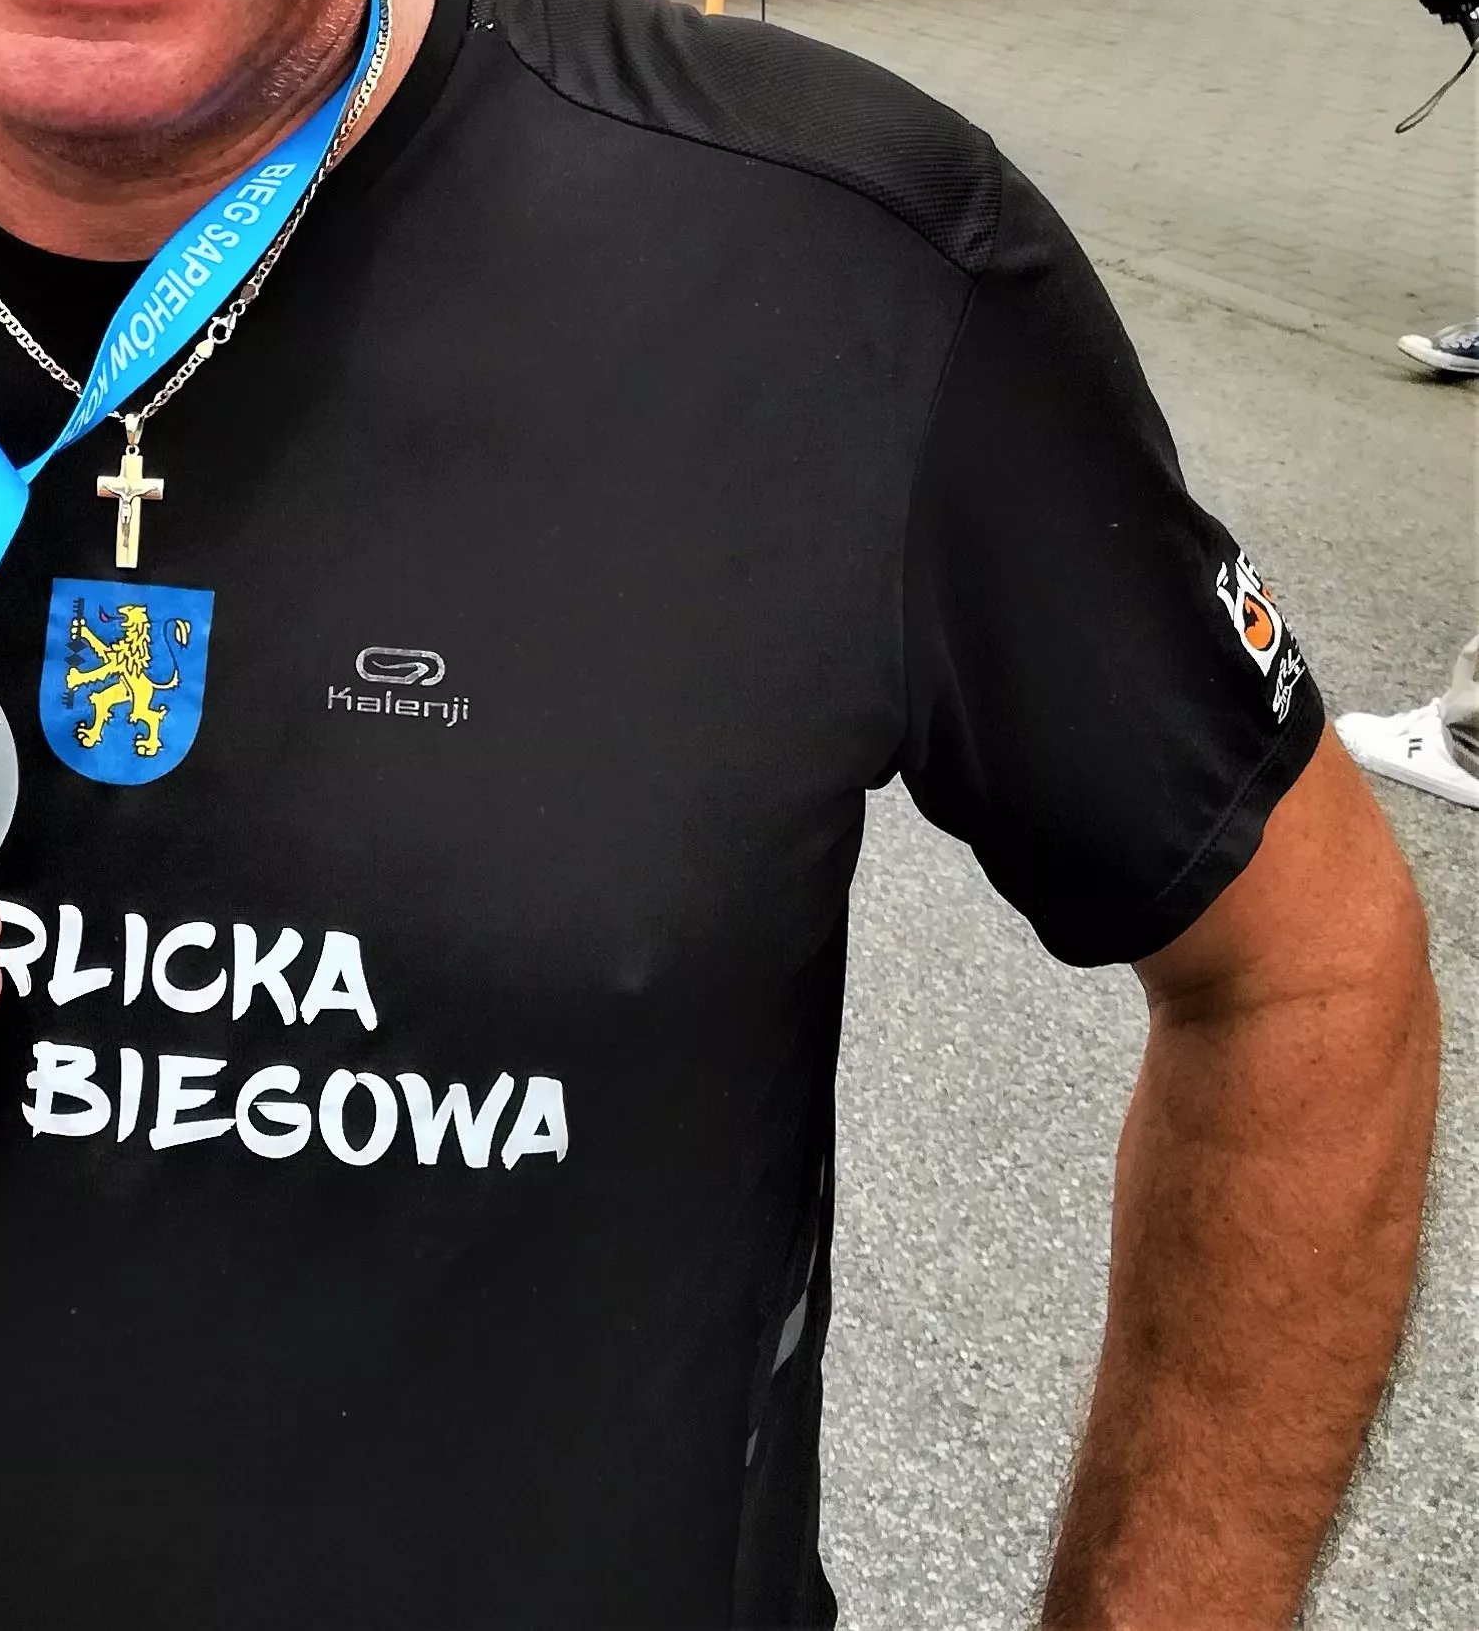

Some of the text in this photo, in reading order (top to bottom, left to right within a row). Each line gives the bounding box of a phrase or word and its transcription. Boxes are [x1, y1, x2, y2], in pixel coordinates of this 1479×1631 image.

[222, 162, 297, 227] BIEG
[108, 223, 240, 381] SAPIEHÓW
[327, 685, 470, 728] Kalenji
[21, 1041, 569, 1170] BIEGOWA
